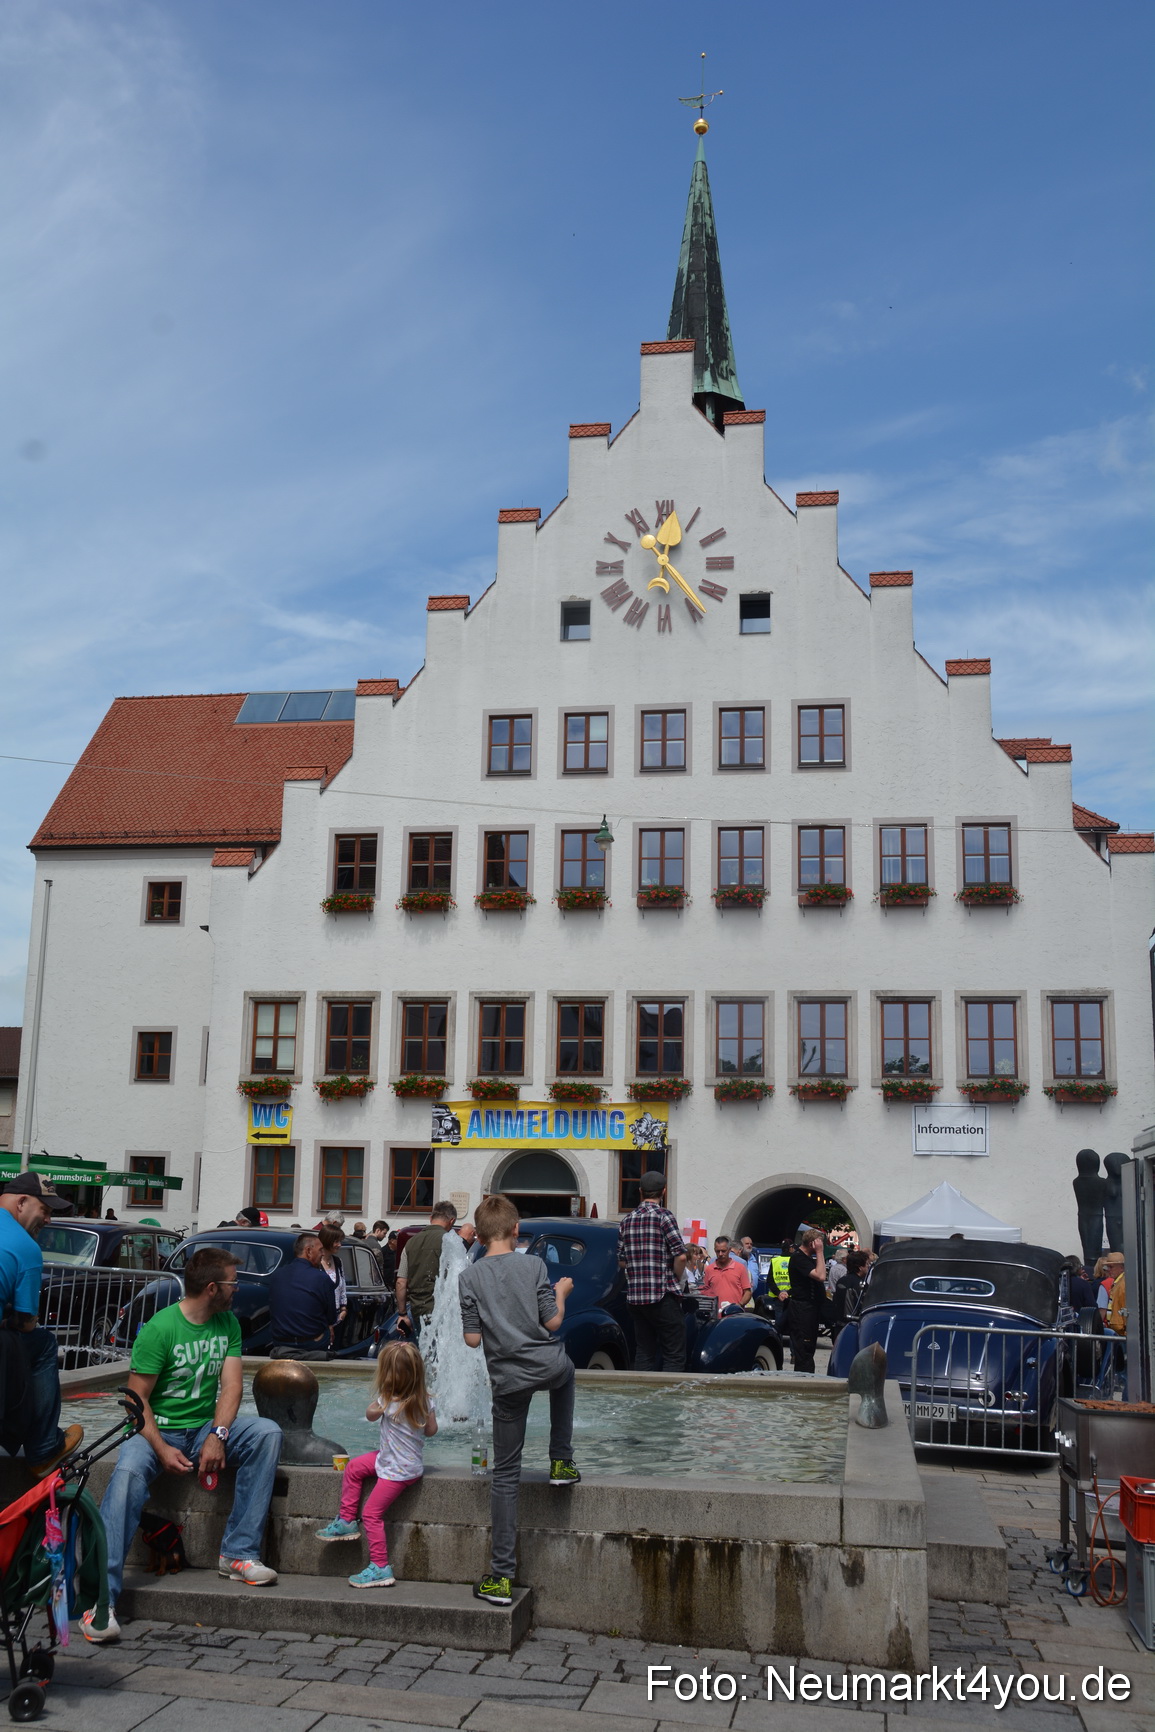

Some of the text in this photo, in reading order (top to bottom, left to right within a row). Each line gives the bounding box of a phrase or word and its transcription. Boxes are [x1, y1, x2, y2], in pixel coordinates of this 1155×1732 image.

[252, 1102, 290, 1128] WC
[466, 1109, 627, 1140] ANMELDUNG
[917, 1123, 984, 1135] Information
[49, 1172, 92, 1182] Lammsbräu
[173, 1335, 229, 1367] SUPER
[207, 1360, 224, 1376] DR
[161, 1363, 206, 1399] 21
[916, 1405, 930, 1417] MM
[932, 1406, 944, 1418] 29
